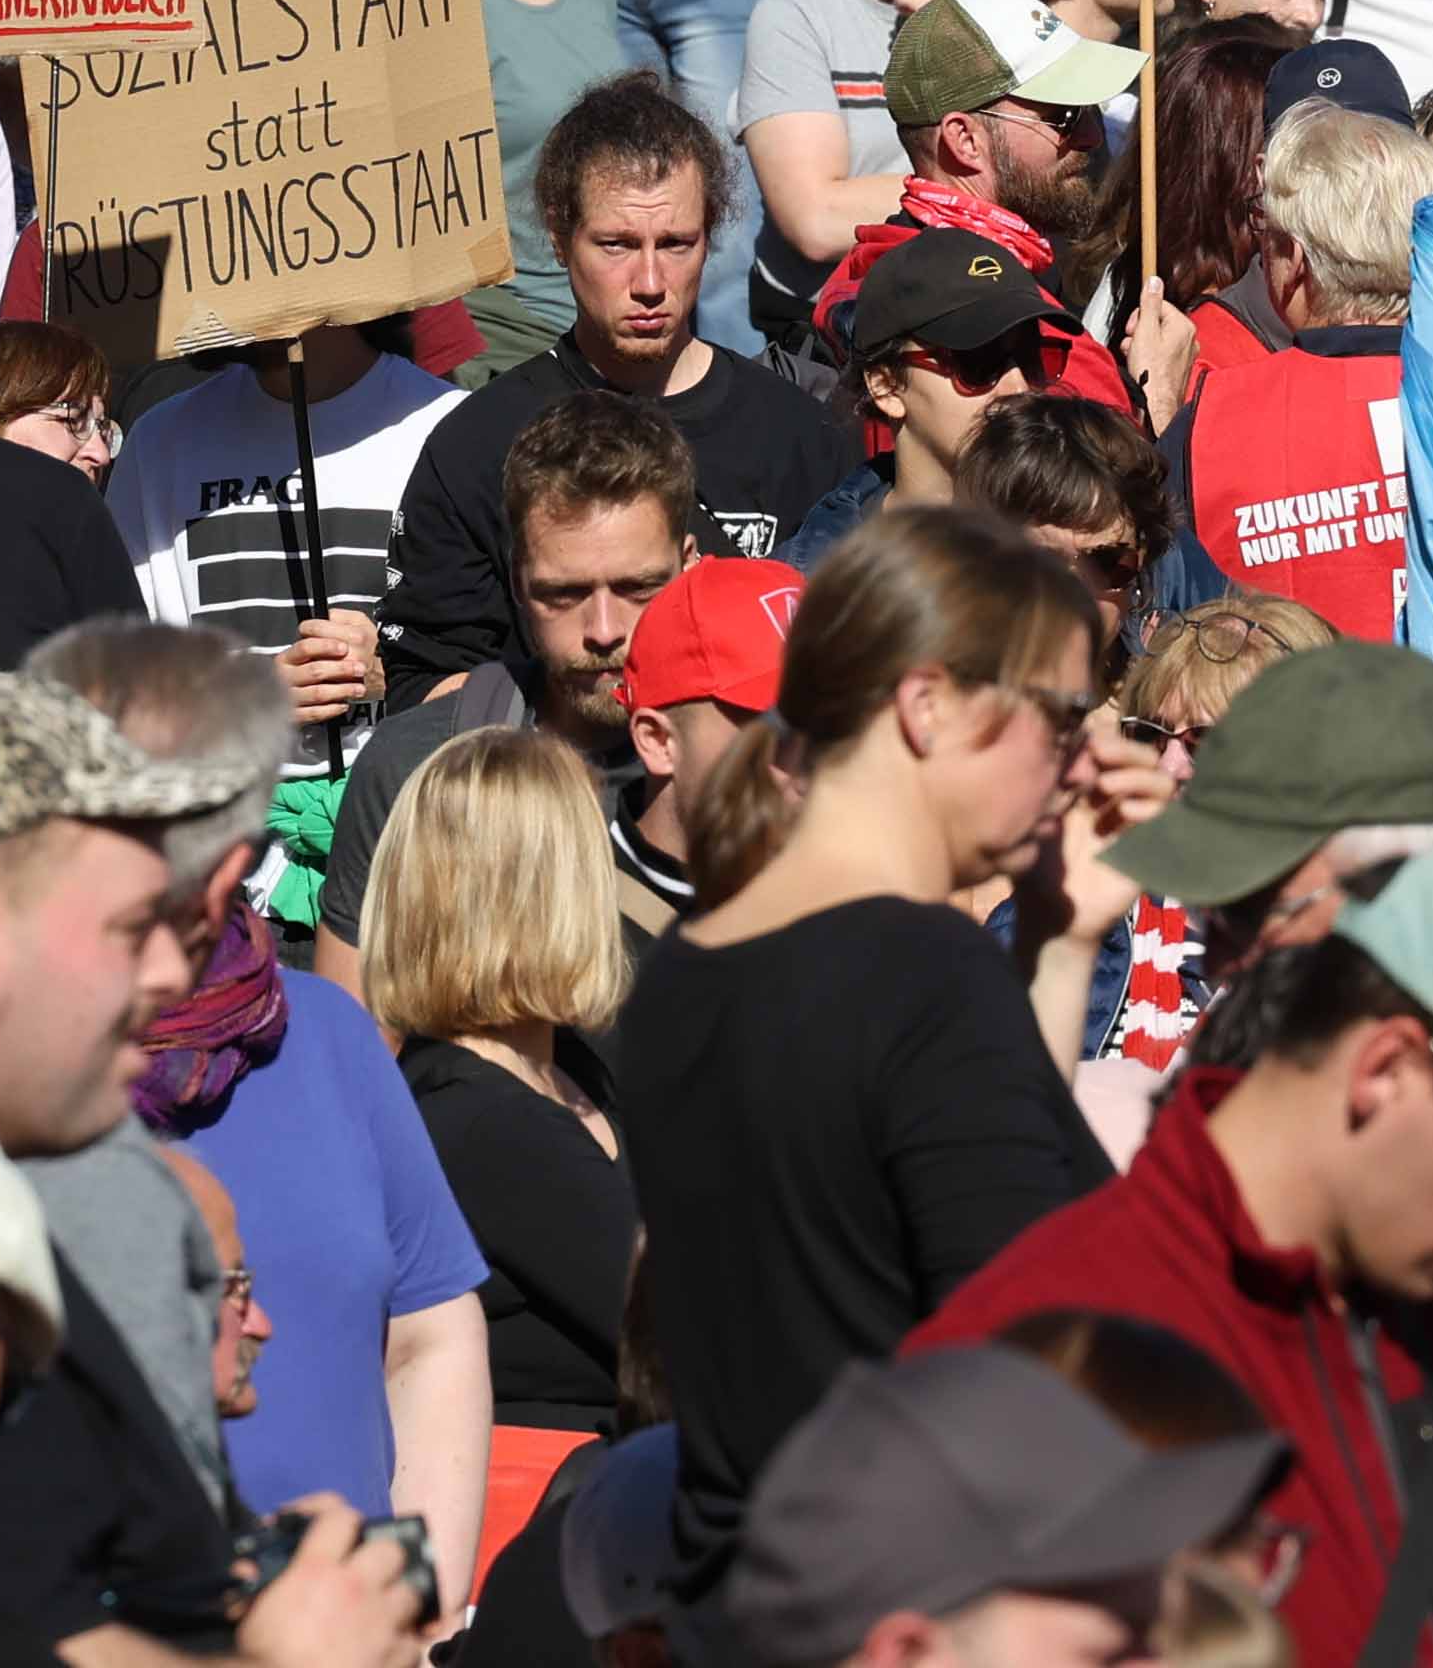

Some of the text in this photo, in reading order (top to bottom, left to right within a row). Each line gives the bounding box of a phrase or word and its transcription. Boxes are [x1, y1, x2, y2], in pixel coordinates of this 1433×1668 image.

[206, 80, 343, 172] statt
[56, 128, 495, 315] RÜSTUNGSSTAAT
[1234, 481, 1379, 538] ZUKUNFT
[1240, 511, 1409, 567] NUR MIT UN
